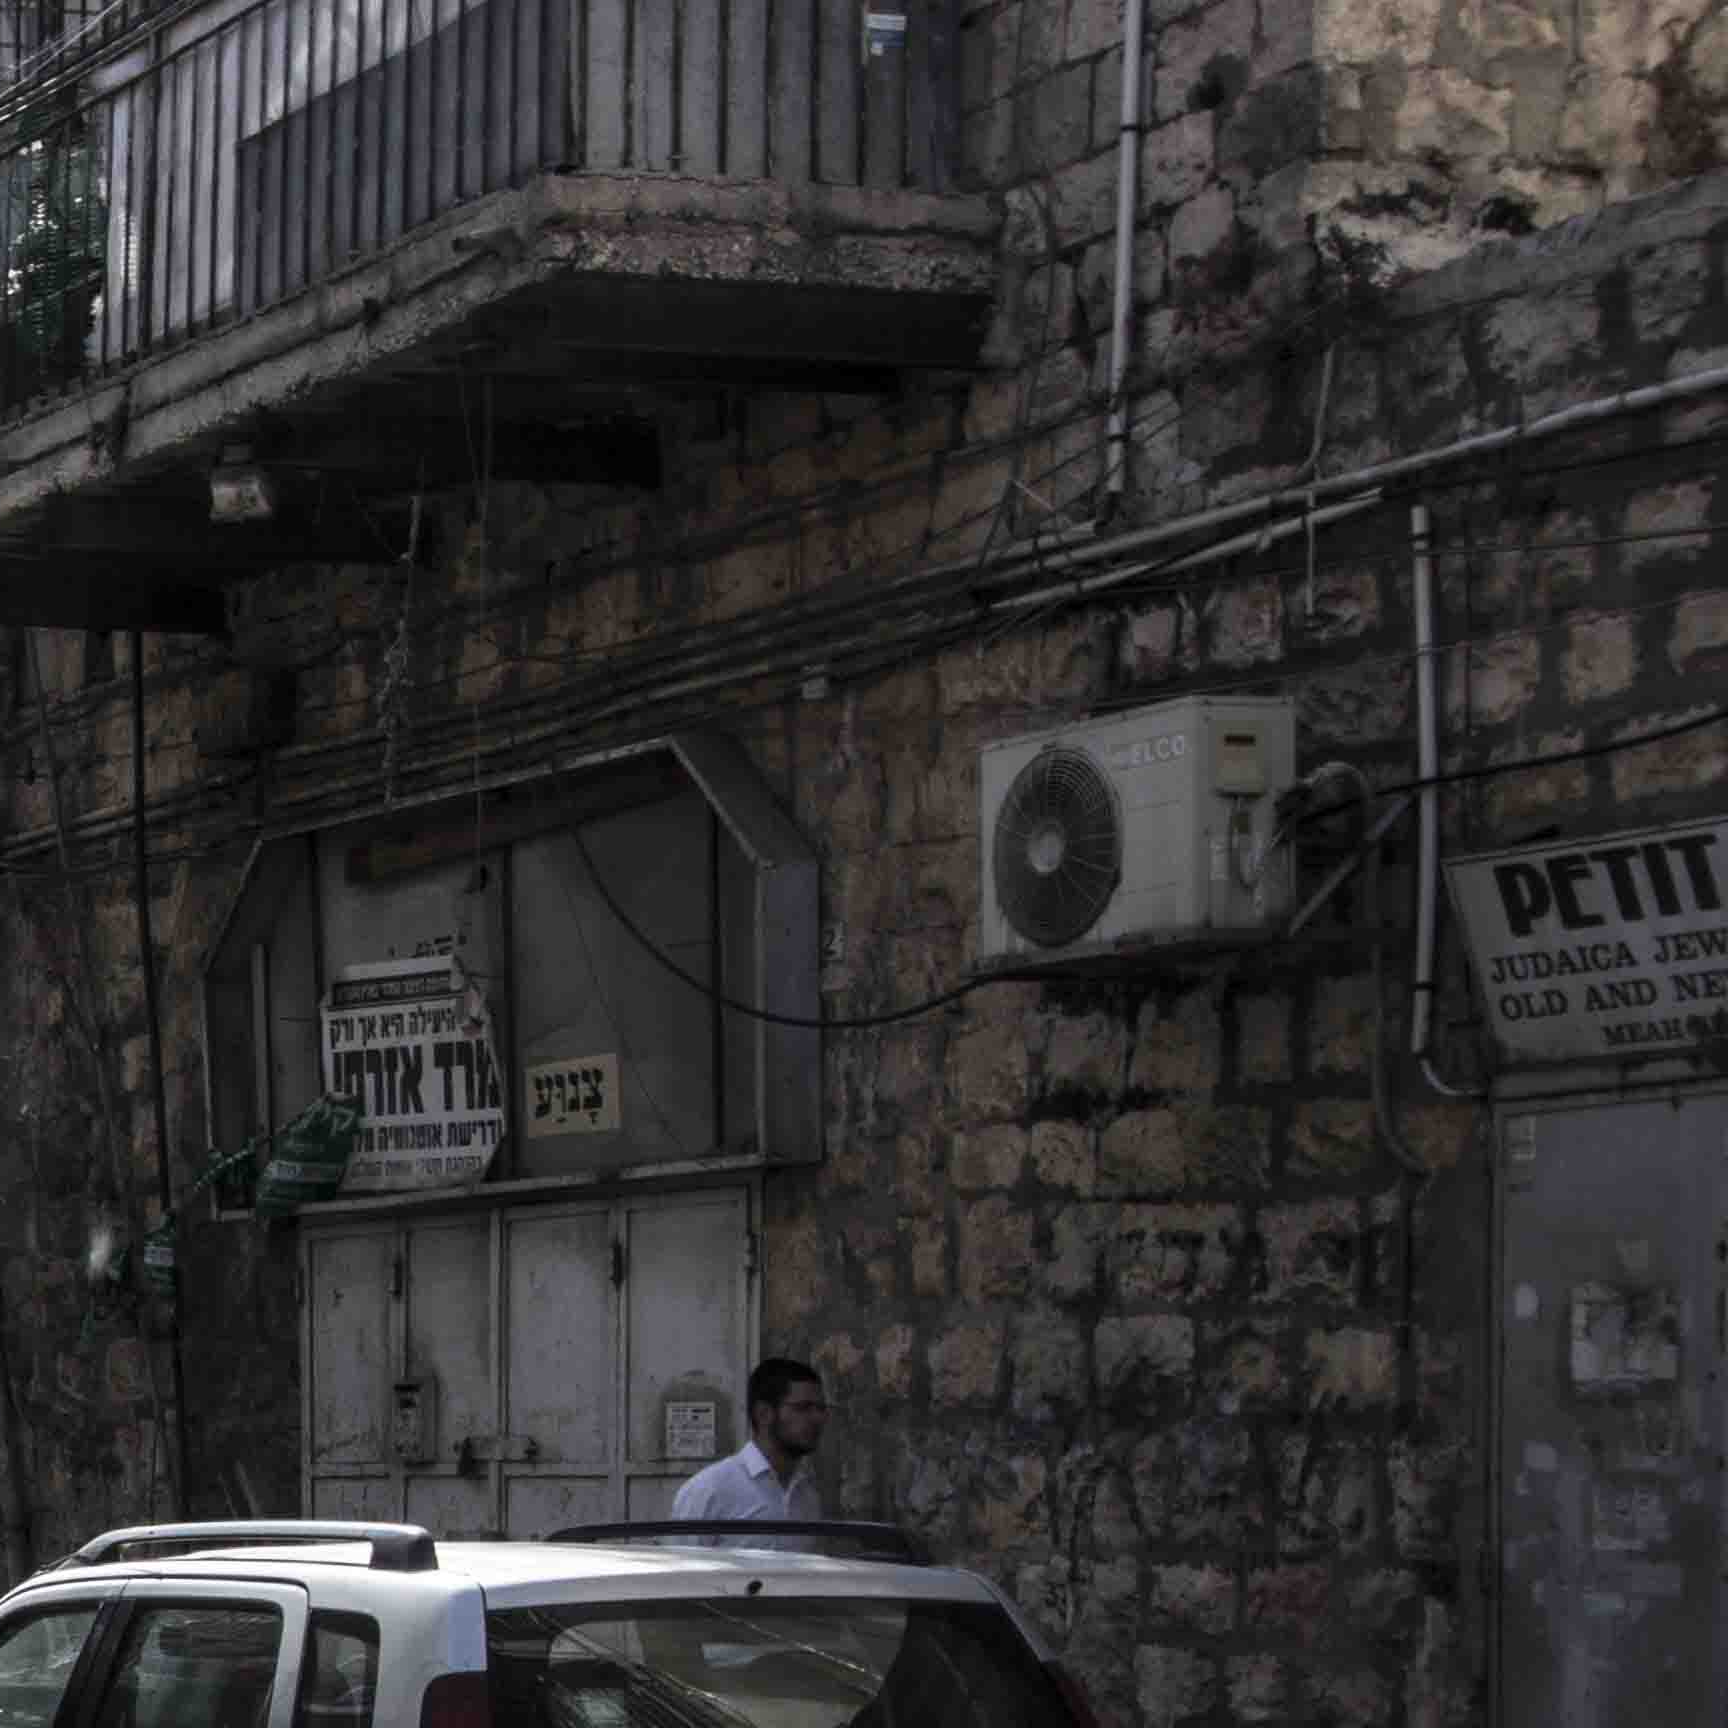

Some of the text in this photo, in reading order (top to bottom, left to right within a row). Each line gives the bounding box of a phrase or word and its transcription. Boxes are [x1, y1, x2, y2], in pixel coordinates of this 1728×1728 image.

[1494, 834, 1721, 936] PETIT
[1490, 941, 1638, 983] JUDAICA
[1500, 968, 1728, 1021] OLD AND NE
[434, 1039, 500, 1111] מרד
